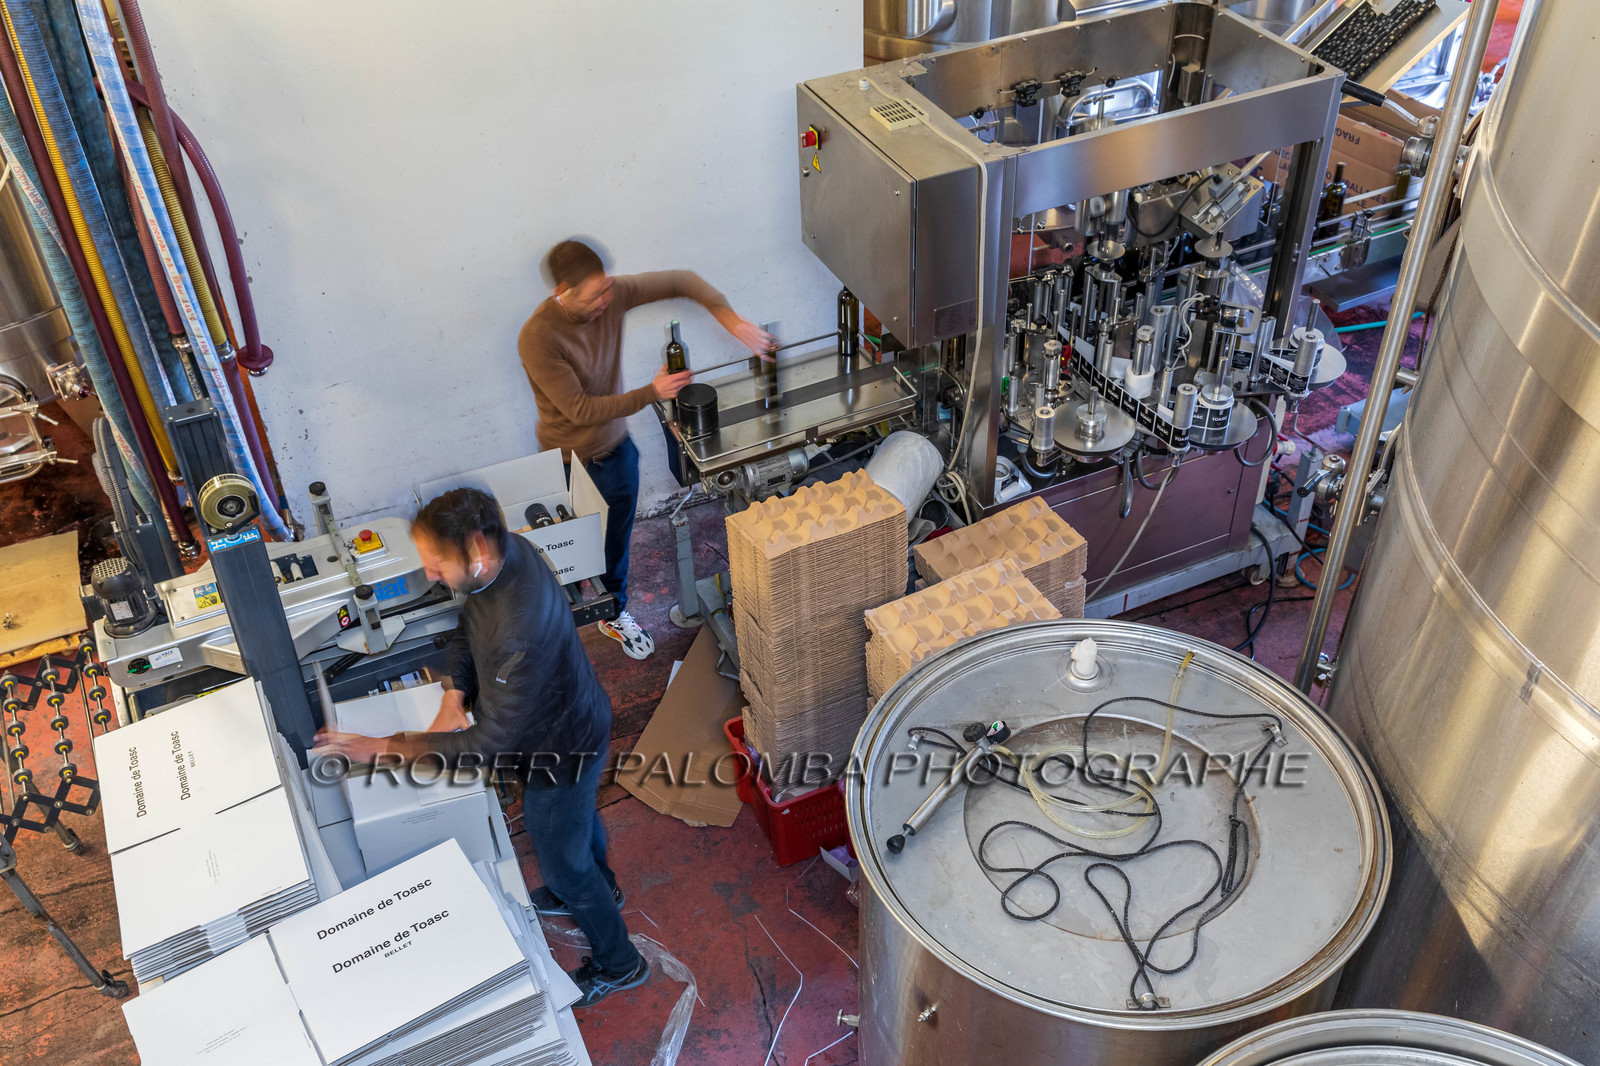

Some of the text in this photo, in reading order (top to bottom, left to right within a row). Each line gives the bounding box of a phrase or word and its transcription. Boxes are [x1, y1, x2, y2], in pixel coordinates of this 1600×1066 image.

[1335, 128, 1361, 145] FRAG
[136, 185, 146, 200] FDA
[1341, 178, 1388, 205] BALLES
[149, 218, 167, 252] BLOCAPAL
[200, 340, 210, 354] FDA
[545, 539, 575, 552] Toasc
[552, 565, 575, 576] oasc
[170, 730, 191, 800] Domaine de Toasc
[128, 746, 147, 818] Domaine de Toasc
[316, 879, 432, 940] Domaine de Toasc
[332, 910, 450, 973] Domaine de Toasc
[384, 940, 413, 958] BELLET
